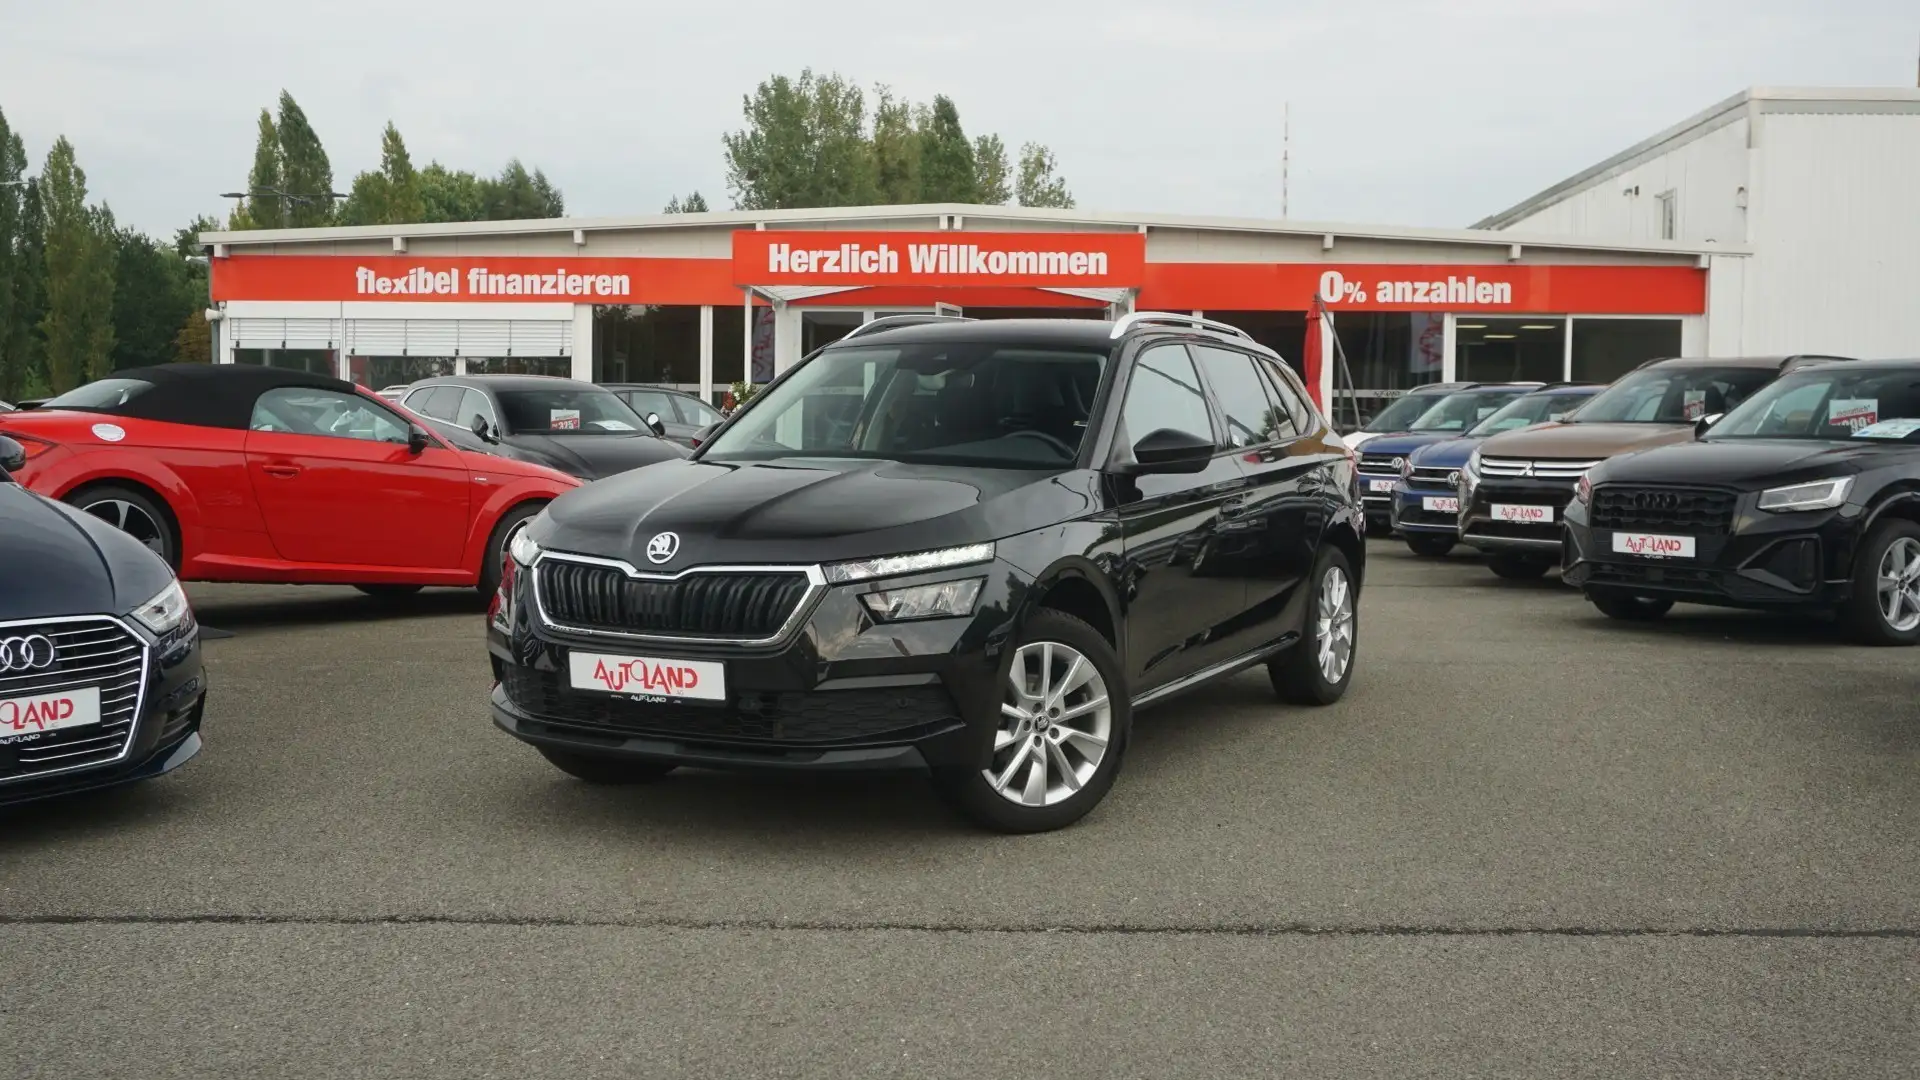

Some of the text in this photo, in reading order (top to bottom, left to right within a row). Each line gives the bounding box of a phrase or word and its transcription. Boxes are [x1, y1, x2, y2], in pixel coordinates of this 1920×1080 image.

[768, 244, 1108, 275] Herzlich Willkommen
[355, 266, 631, 295] flexibel finanzieren
[1319, 270, 1512, 304] 0% anzahlen
[594, 658, 699, 694] AUTOLAND
[0, 698, 74, 731] OLAND
